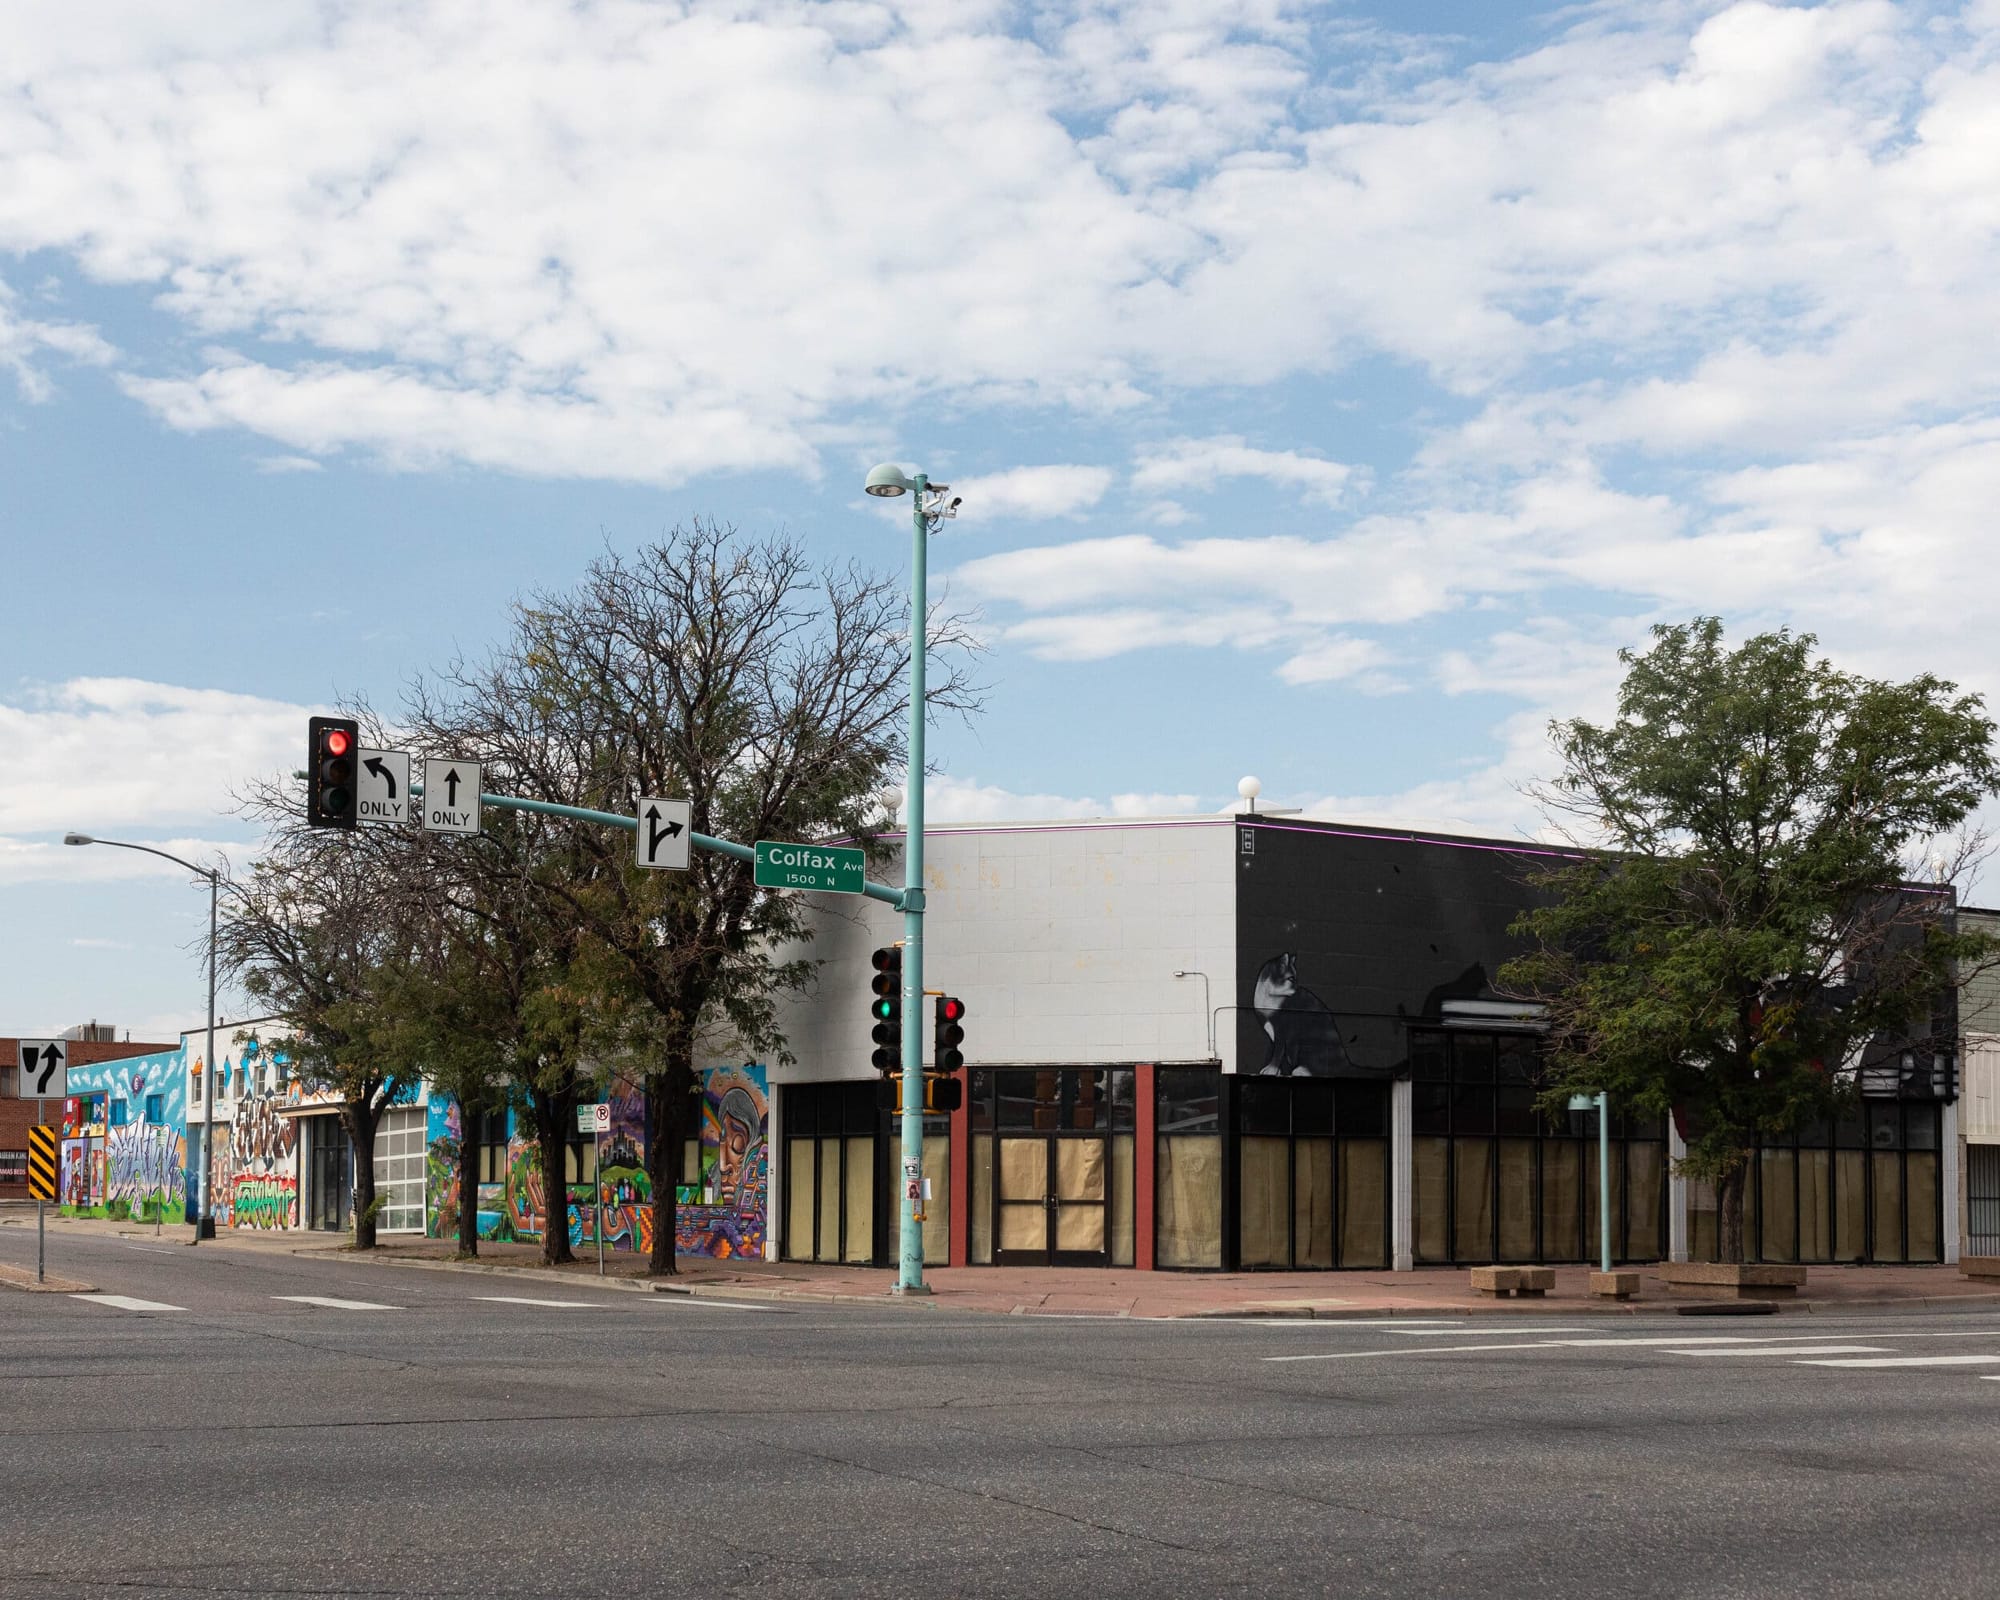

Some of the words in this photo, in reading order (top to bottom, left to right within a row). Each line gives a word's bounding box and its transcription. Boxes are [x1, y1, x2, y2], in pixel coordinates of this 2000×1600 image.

[360, 801, 402, 817] ONLY
[432, 811, 470, 826] ONLY
[756, 854, 764, 864] E
[769, 848, 836, 870] Colfax
[843, 862, 864, 872] Ave
[786, 873, 816, 885] 1500
[827, 877, 835, 886] N
